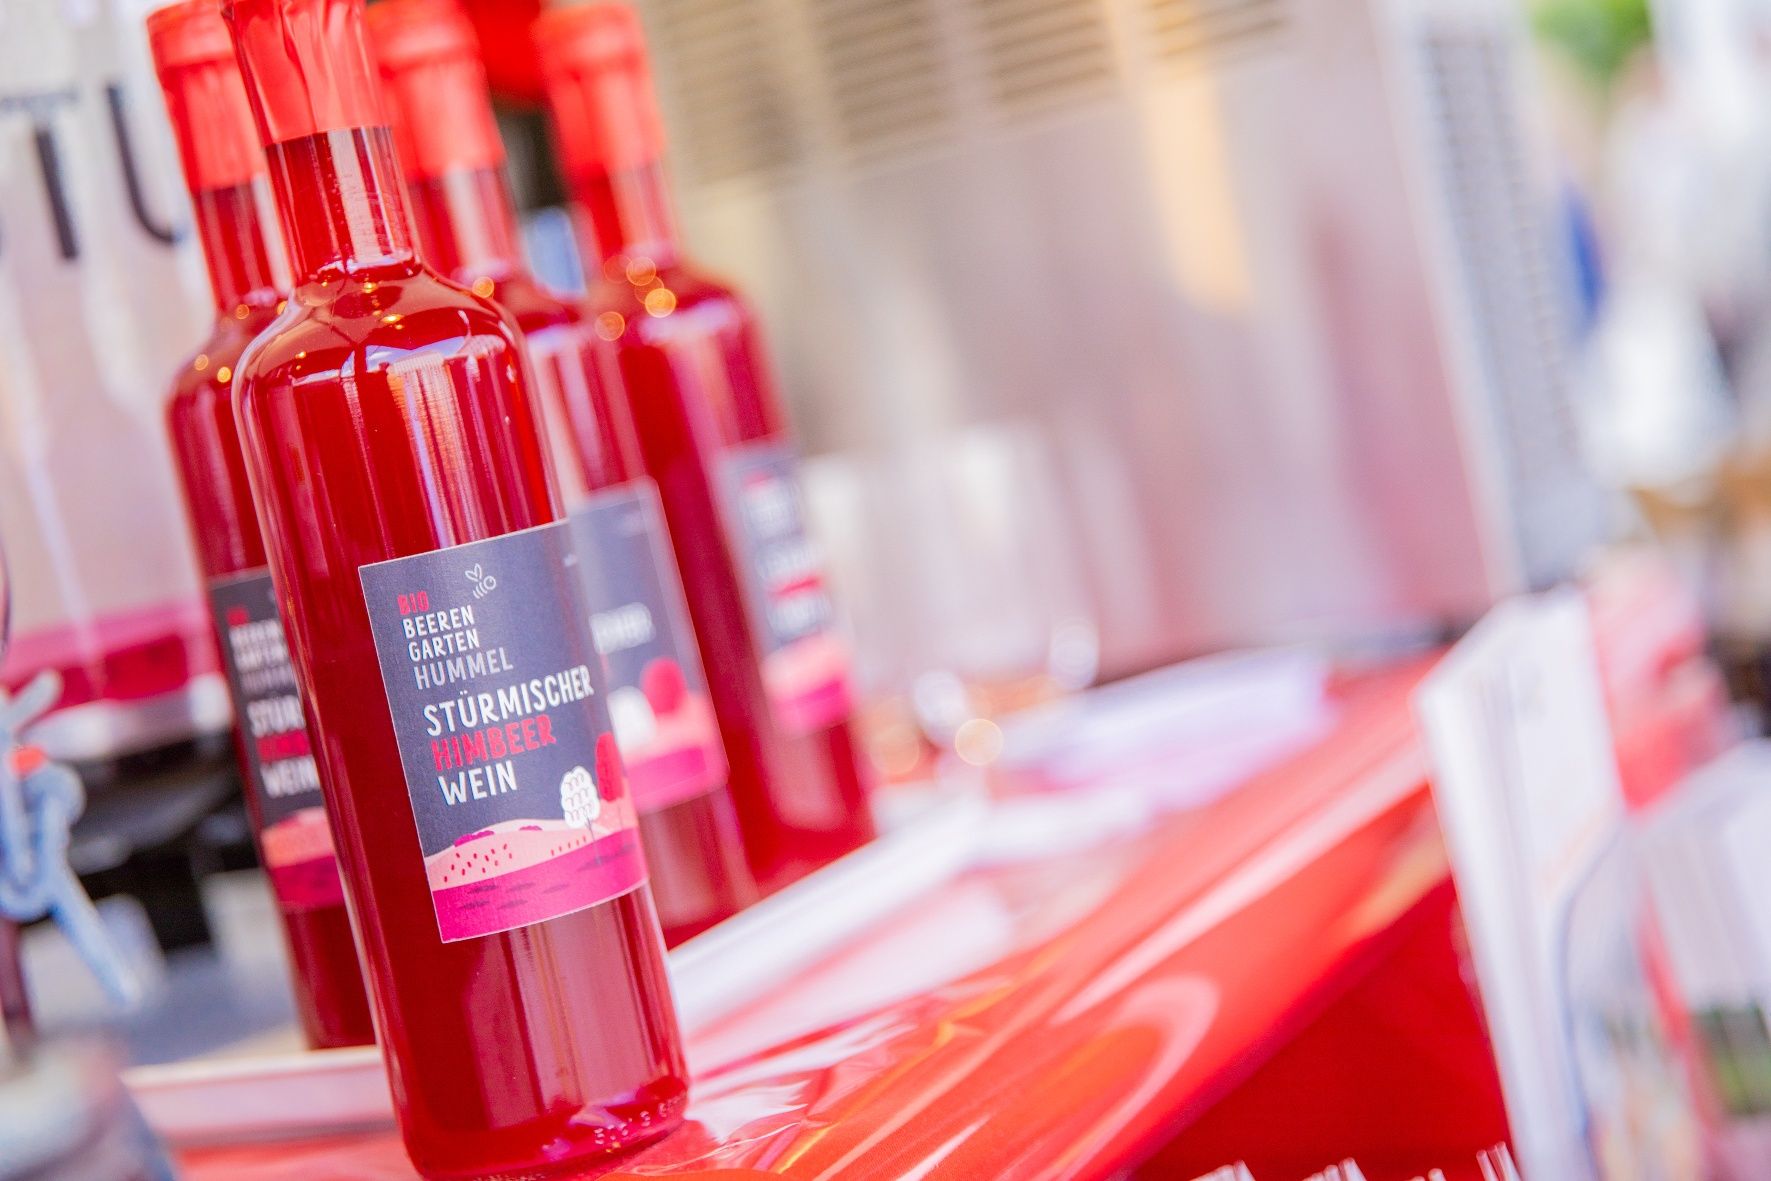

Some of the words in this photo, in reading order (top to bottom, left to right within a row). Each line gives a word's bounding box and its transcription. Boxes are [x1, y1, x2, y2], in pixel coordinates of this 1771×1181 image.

[397, 591, 430, 616] BIO
[402, 604, 476, 639] BEEREN
[408, 628, 481, 662] GARTEN
[413, 647, 514, 690] HUMMEL
[423, 664, 595, 737] STÜRMISCHER
[431, 713, 557, 772] HIMBEER
[437, 759, 518, 806] WEIN
